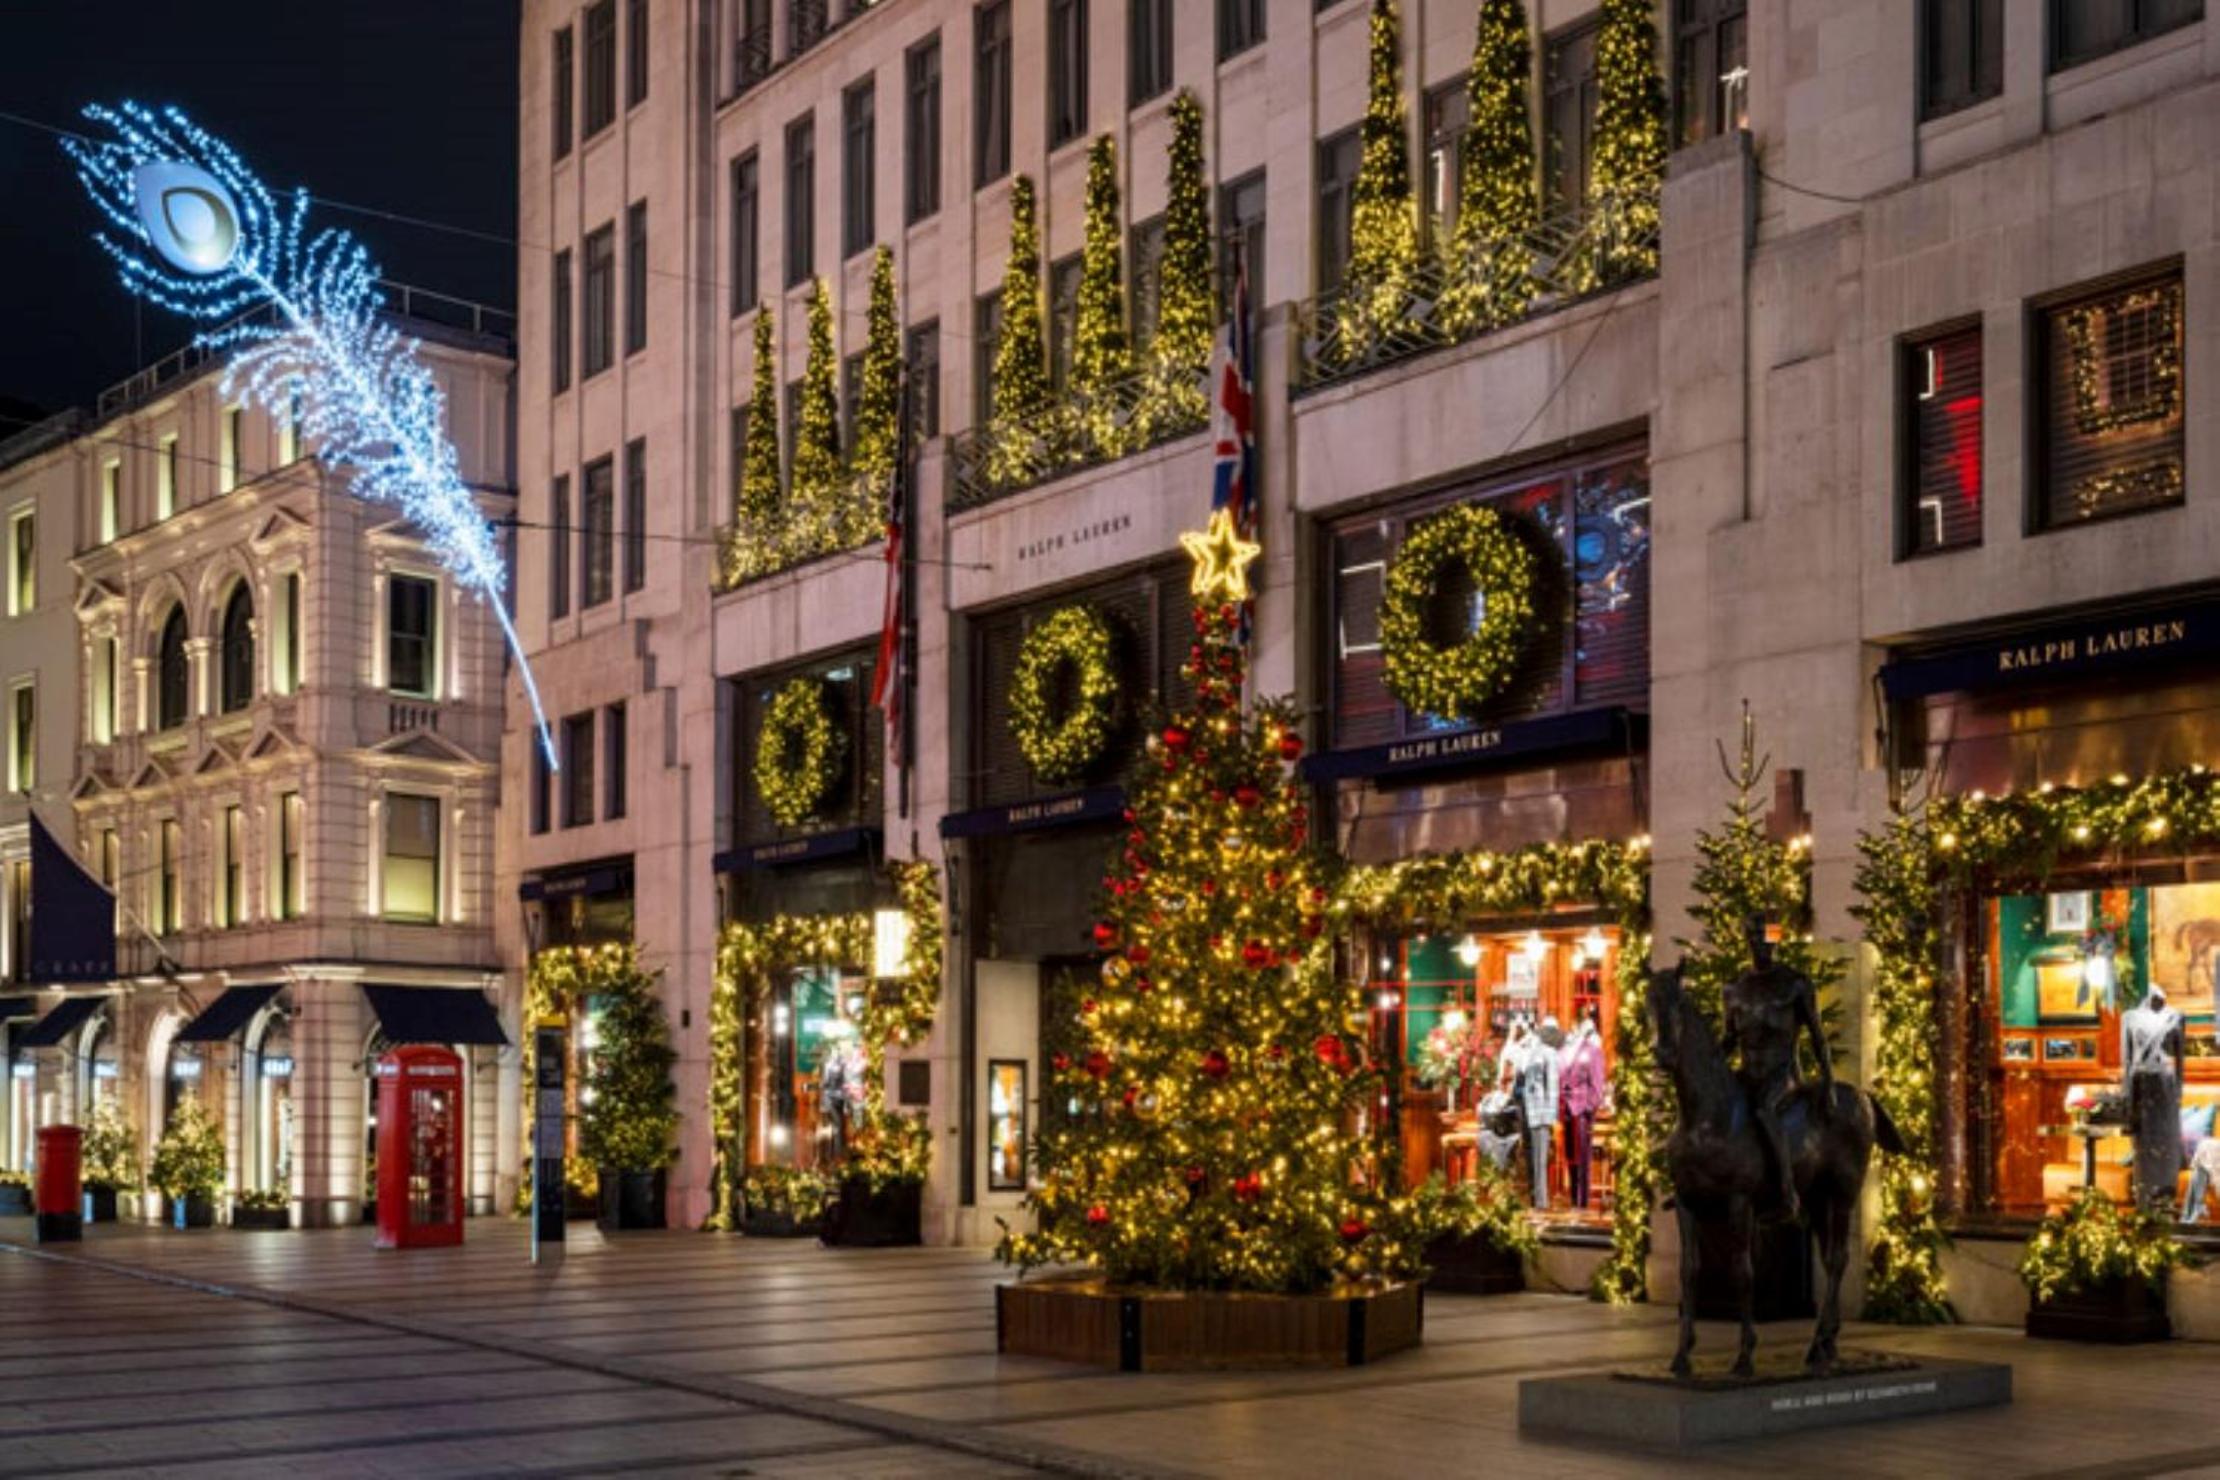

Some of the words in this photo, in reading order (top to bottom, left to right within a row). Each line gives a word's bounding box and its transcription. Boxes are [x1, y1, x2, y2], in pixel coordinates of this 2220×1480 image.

[1018, 534, 1064, 560] RALPH
[1073, 515, 1131, 544] LAUREN
[1998, 639, 2076, 671] RALPH
[2086, 620, 2186, 656] LAUREN
[1388, 741, 1437, 762] RALPH
[1441, 730, 1501, 755] LAUREN
